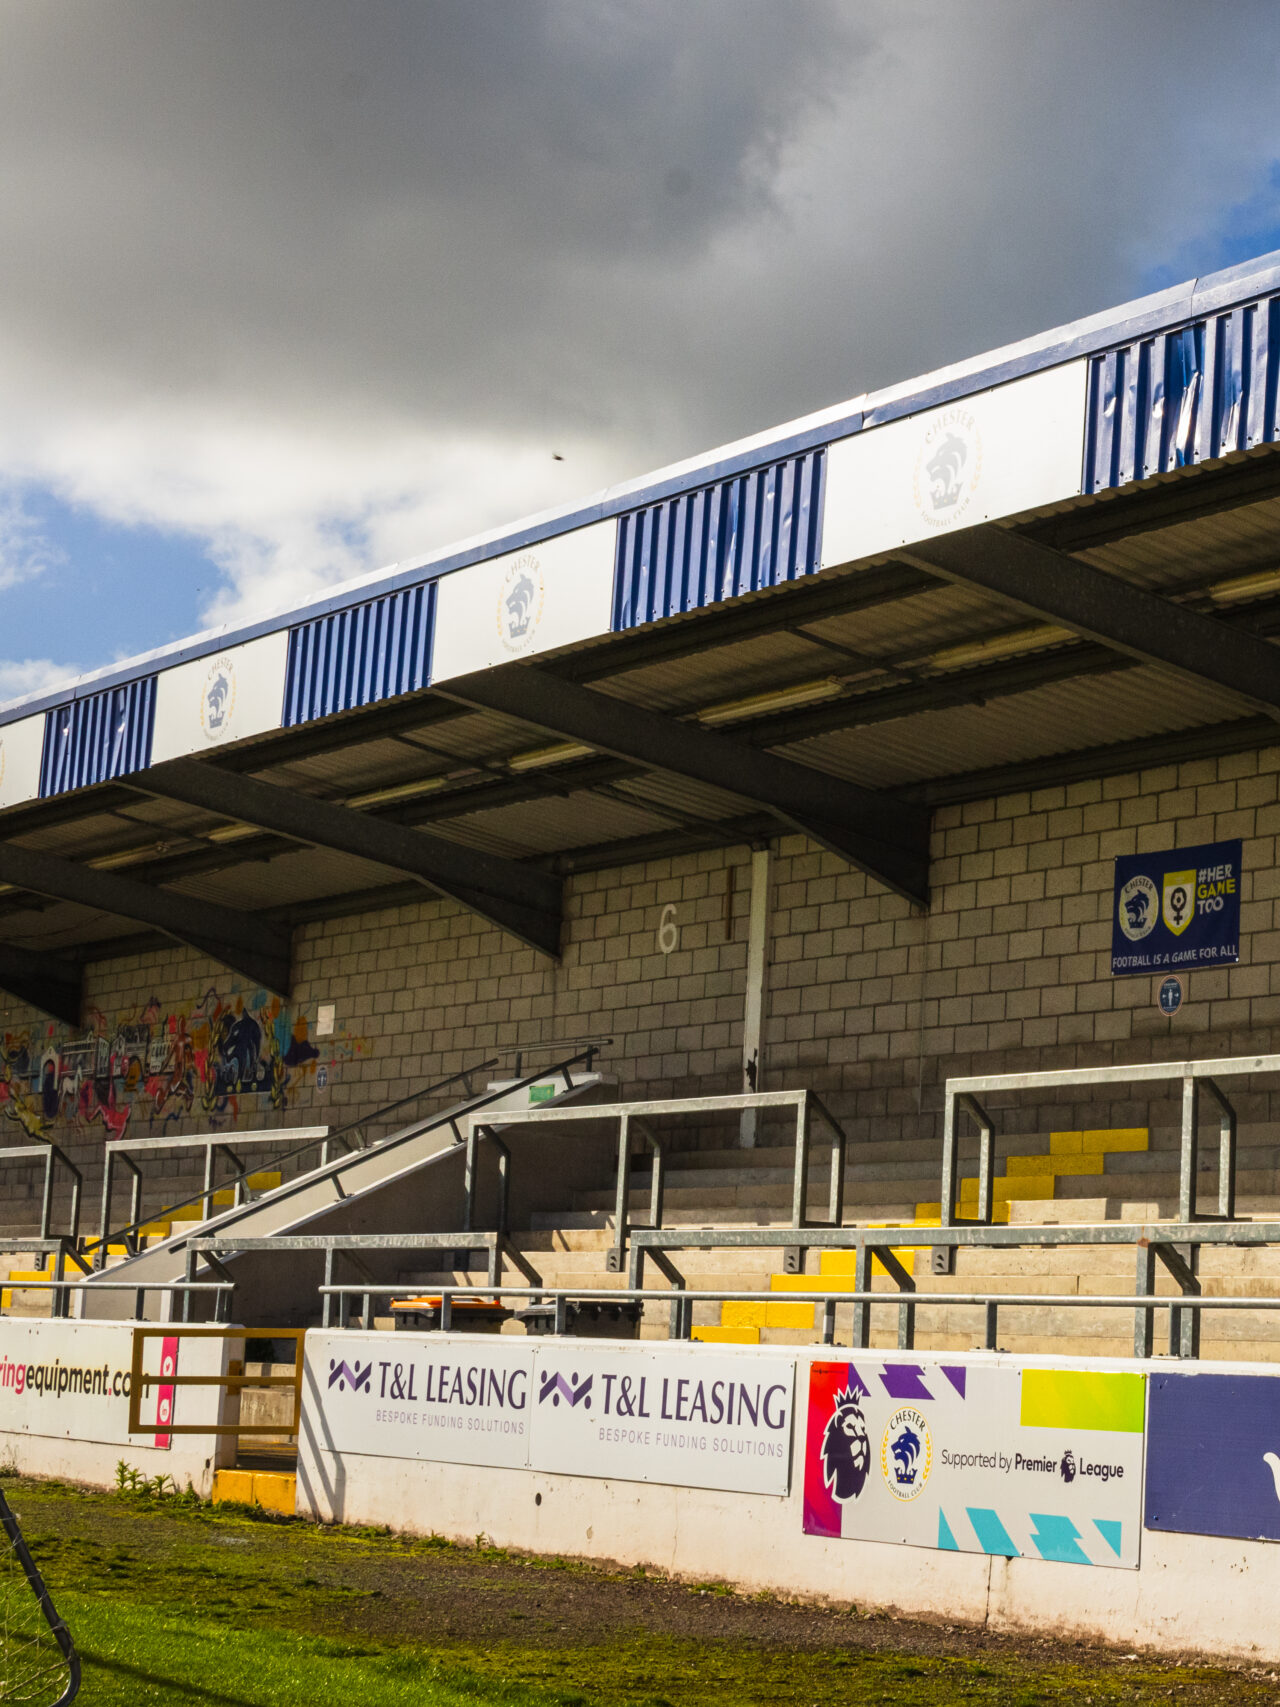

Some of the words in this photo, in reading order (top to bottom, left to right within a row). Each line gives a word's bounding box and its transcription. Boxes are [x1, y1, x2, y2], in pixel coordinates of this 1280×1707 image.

[925, 409, 975, 444] CHESTER
[1125, 878, 1154, 893] CHESTER
[1198, 864, 1232, 883] #HER
[1197, 878, 1236, 899] GAME
[1197, 896, 1224, 915] TOO
[659, 903, 677, 954] 6
[1112, 955, 1151, 968] FOOTBALL
[1153, 953, 1162, 965] IS
[1162, 953, 1170, 964] A
[1171, 949, 1197, 963] GAME
[1200, 946, 1218, 959] FOR
[1220, 944, 1237, 957] ALL
[379, 1361, 418, 1401] T&L
[426, 1364, 528, 1410] LEASING
[601, 1373, 650, 1418] T&L
[660, 1378, 787, 1429] LEASING
[376, 1409, 418, 1425] BESPOKE
[422, 1413, 463, 1430] FUNDING
[467, 1417, 525, 1435] SOLUTIONS
[890, 1410, 926, 1432] CHESTER
[599, 1427, 650, 1445] BESPOKE
[656, 1432, 707, 1450] FUNDING
[713, 1437, 784, 1458] SOLUTIONS
[941, 1449, 997, 1470] Supported
[999, 1451, 1013, 1474] by
[1014, 1453, 1057, 1473] Premier
[1079, 1457, 1124, 1482] League
